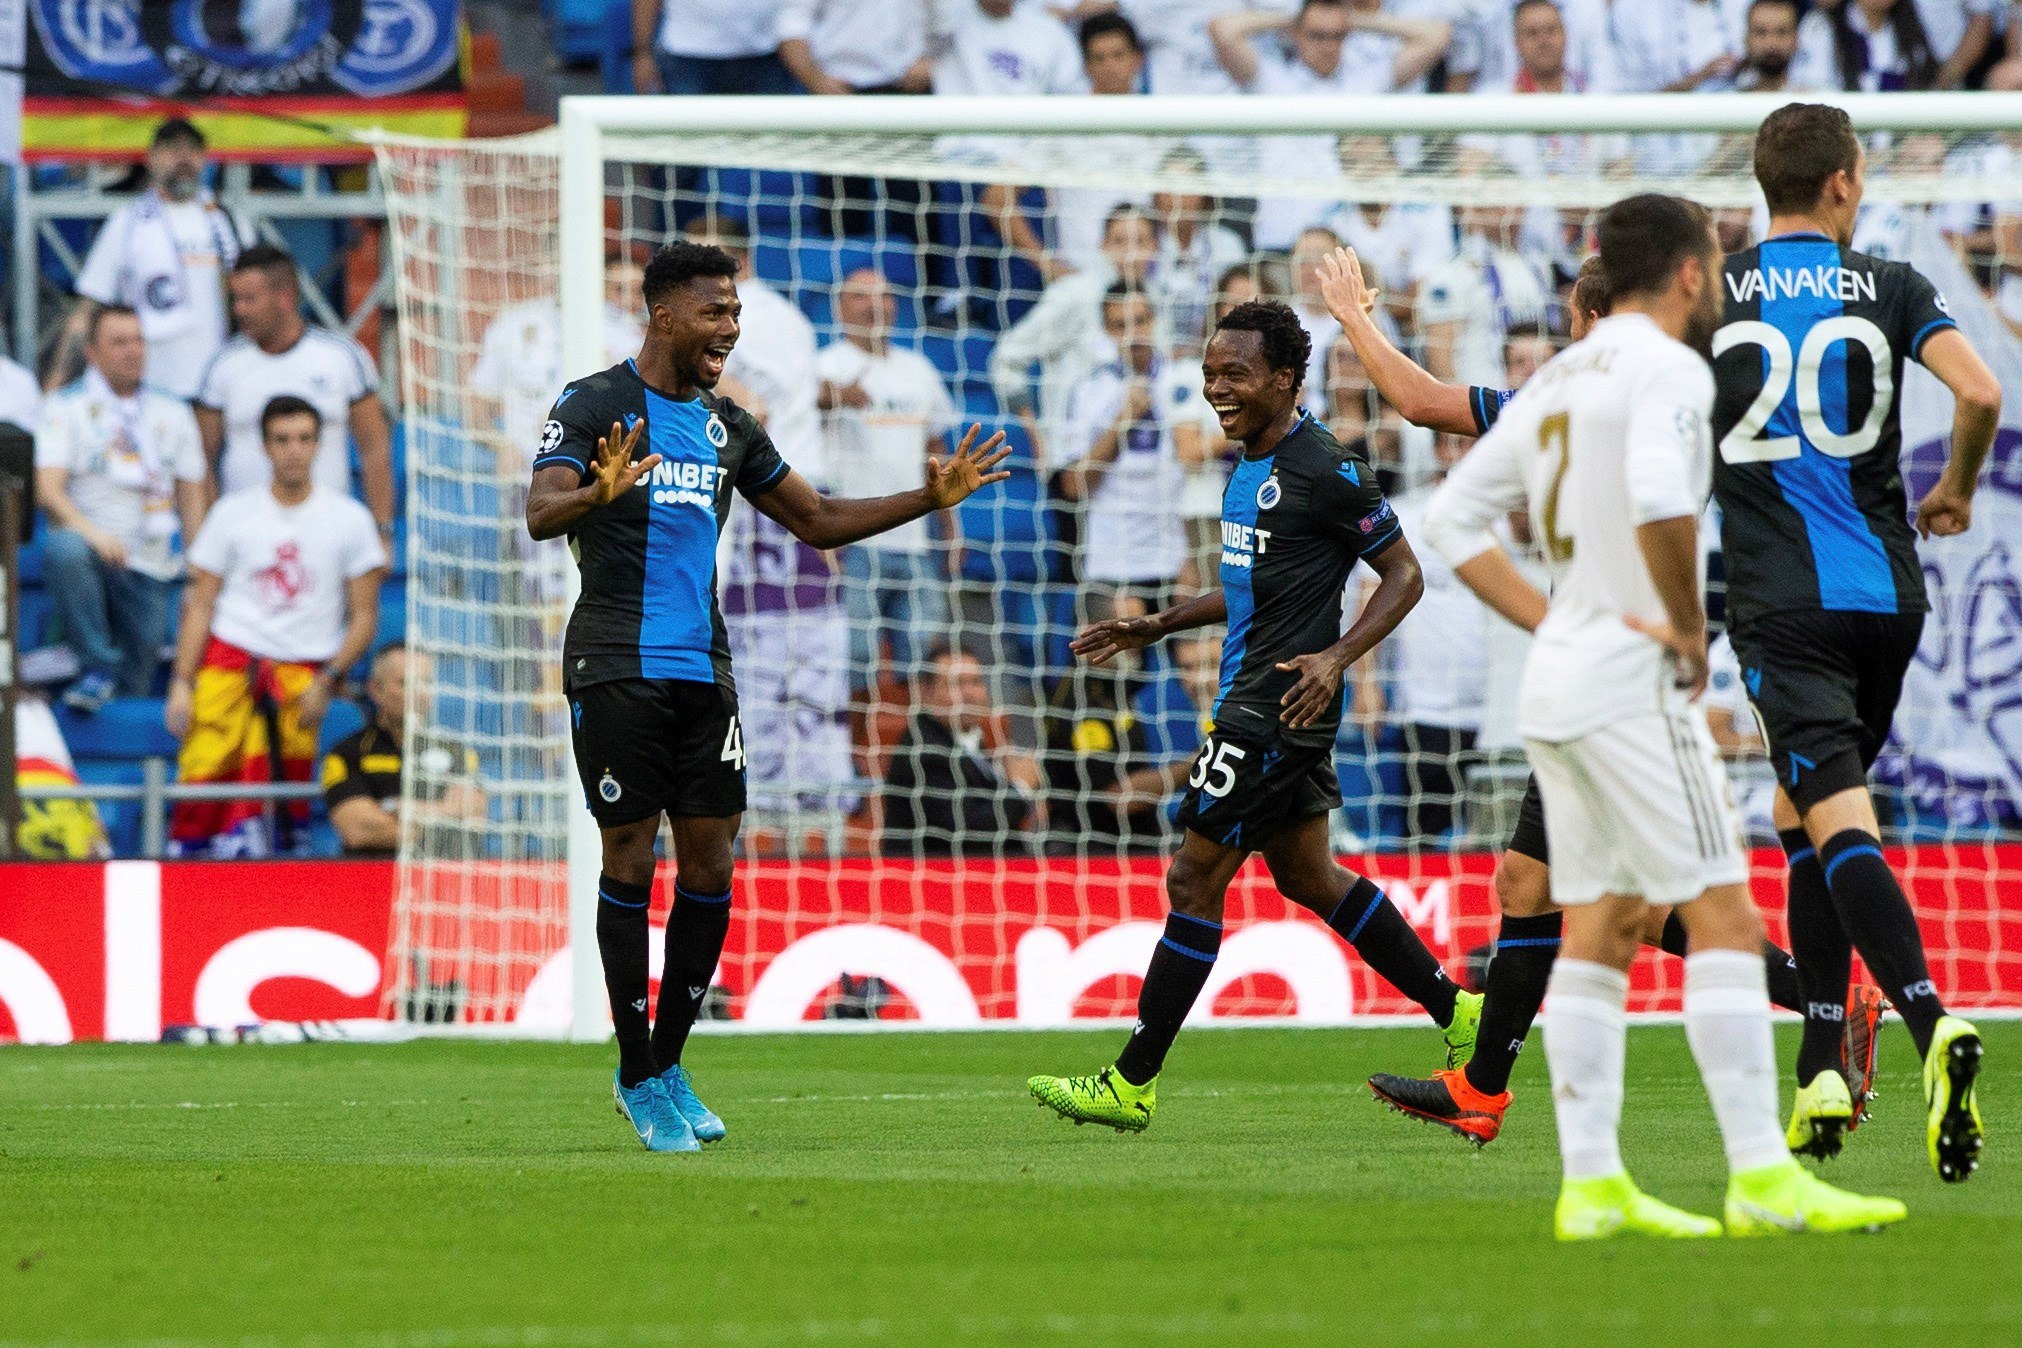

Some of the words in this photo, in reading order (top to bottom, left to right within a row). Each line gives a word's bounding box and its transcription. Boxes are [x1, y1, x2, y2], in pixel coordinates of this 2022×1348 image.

[1725, 264, 1877, 303] VANAKEN
[1711, 315, 1894, 465] 20
[1538, 408, 1575, 563] 2
[1189, 735, 1246, 798] 35
[1808, 1001, 1845, 1022] FCB
